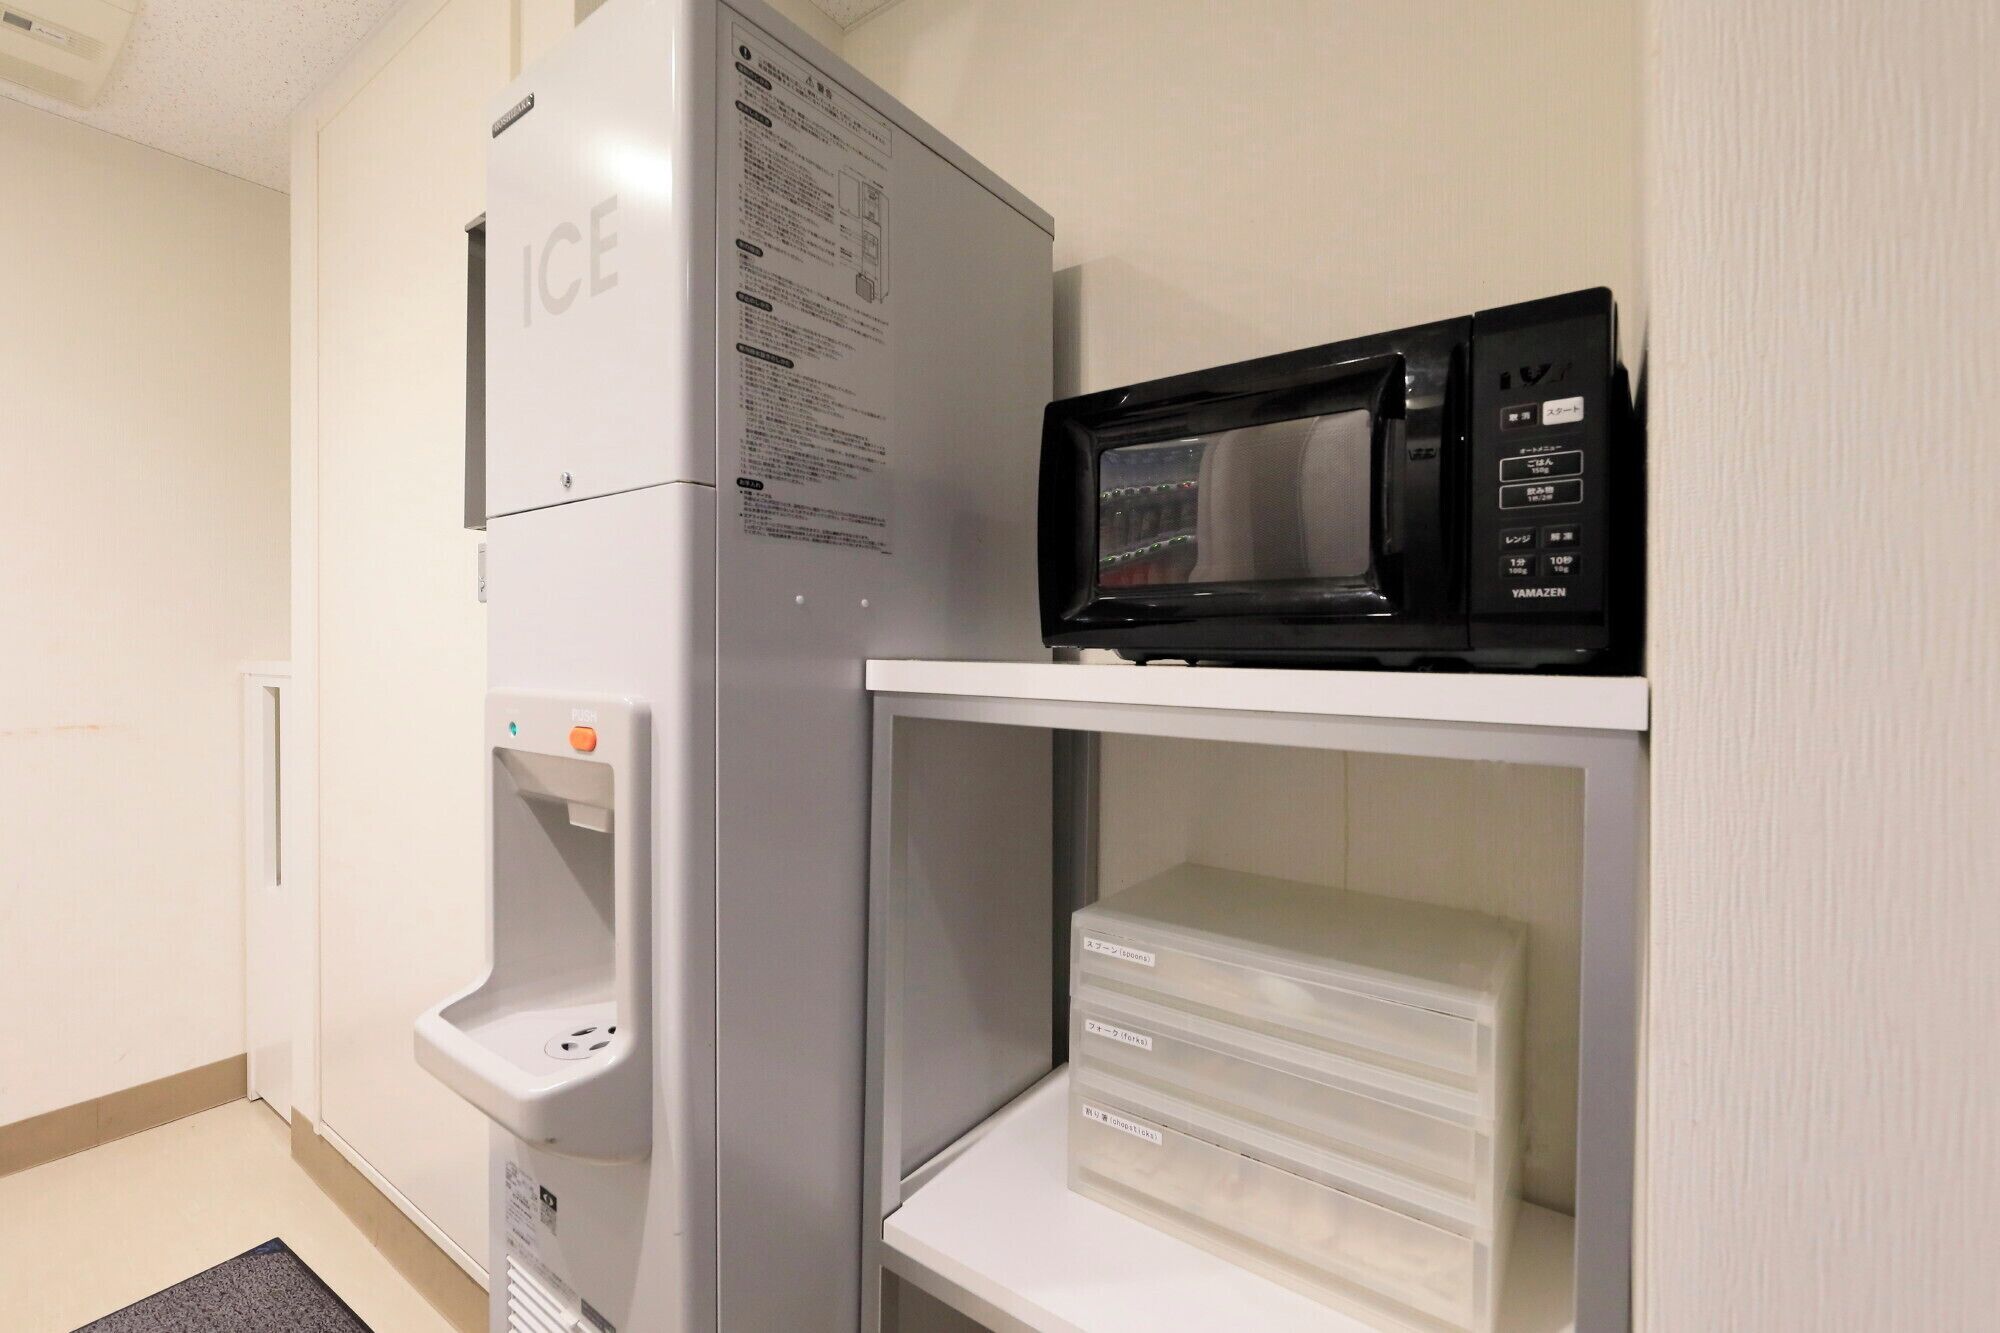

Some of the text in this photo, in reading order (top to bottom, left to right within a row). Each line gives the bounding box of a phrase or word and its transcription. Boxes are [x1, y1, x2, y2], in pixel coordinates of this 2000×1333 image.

[523, 194, 619, 328] ICE
[1547, 405, 1581, 416] スタート
[1527, 458, 1554, 468] ごはん
[1505, 534, 1531, 544] レンジ
[1510, 558, 1526, 567] 1分
[1550, 556, 1573, 565] 10秒
[1511, 588, 1567, 598] YAMAZEN
[571, 708, 598, 722] PUSH
